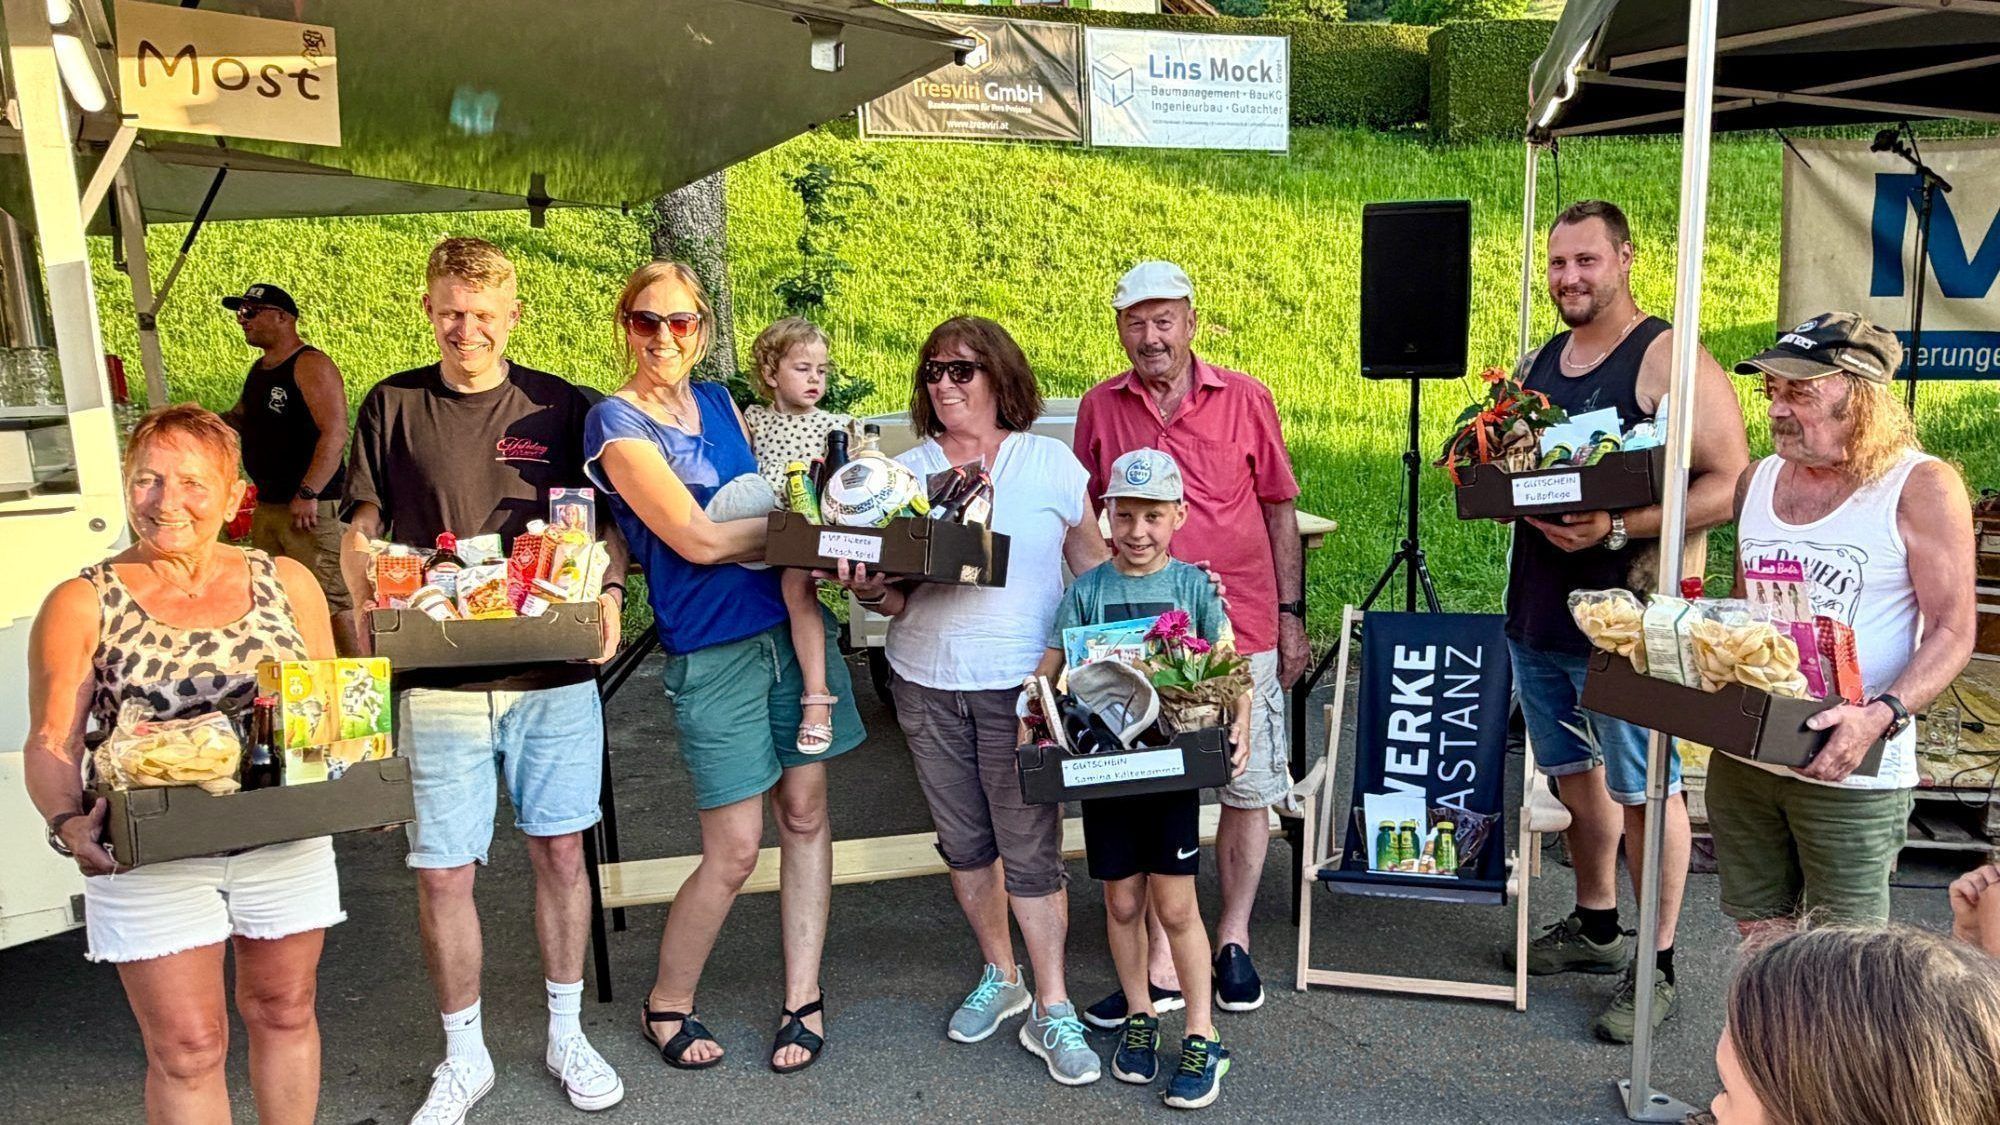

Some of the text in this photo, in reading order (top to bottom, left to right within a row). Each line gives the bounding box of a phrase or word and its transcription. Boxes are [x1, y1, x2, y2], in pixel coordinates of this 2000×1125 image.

[137, 39, 320, 101] Most
[1149, 54, 1274, 83] Lins Mock
[913, 79, 1044, 104] Tresviri GmbH
[1151, 85, 1282, 101] Baumanagement BauKG
[1151, 100, 1283, 115] Ingenieurbau Gutachter
[1523, 476, 1576, 489] GUTSCHEIN
[1072, 758, 1127, 771] GUTSCHEIN
